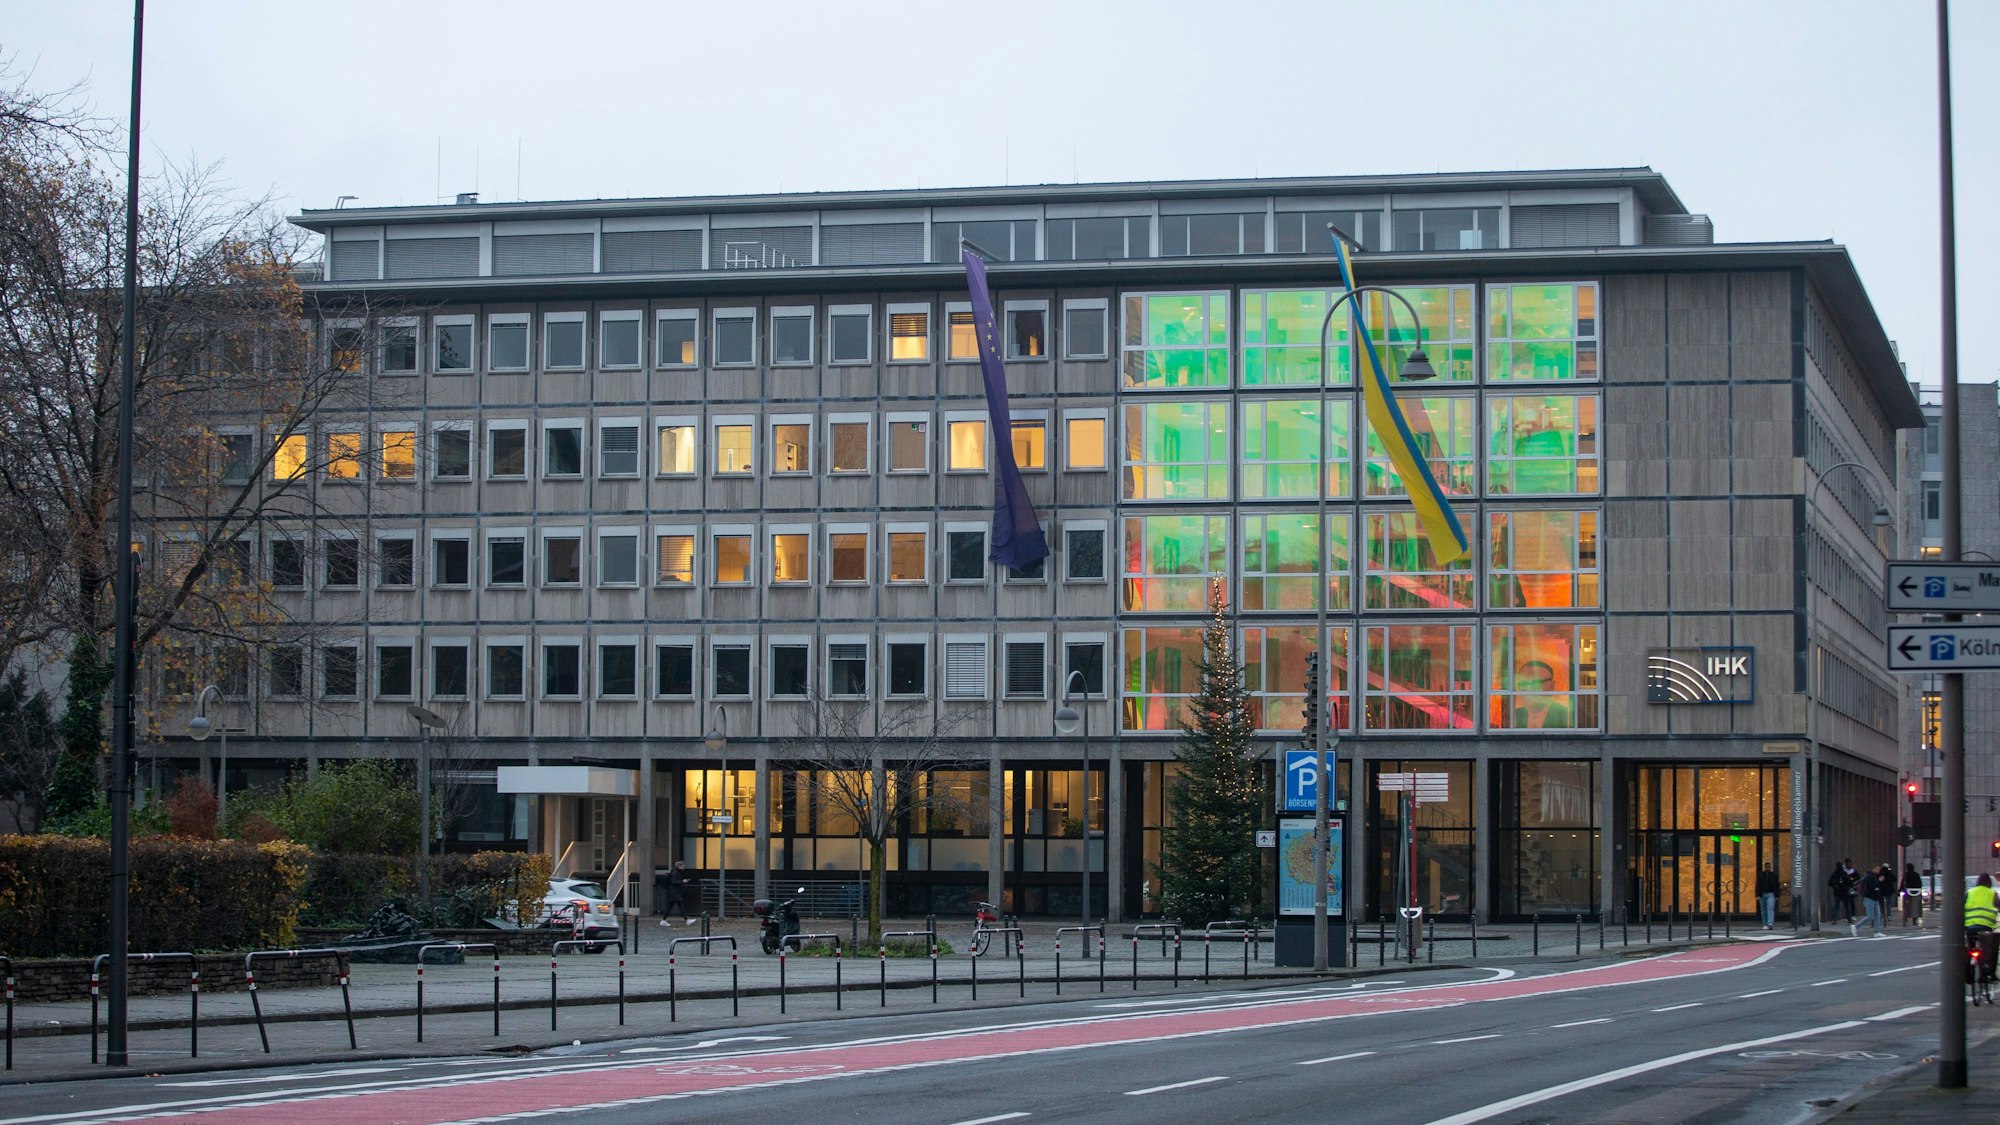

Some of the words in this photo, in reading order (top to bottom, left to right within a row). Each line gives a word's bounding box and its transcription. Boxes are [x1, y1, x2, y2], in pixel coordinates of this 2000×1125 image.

[1978, 573, 2000, 587] Ma
[1960, 639, 2000, 656] Köln
[1707, 656, 1748, 676] IHK
[1298, 768, 1318, 796] P
[1794, 771, 1802, 830] Handelskammer
[1794, 834, 1802, 848] und
[1794, 850, 1802, 888] Industrie-
